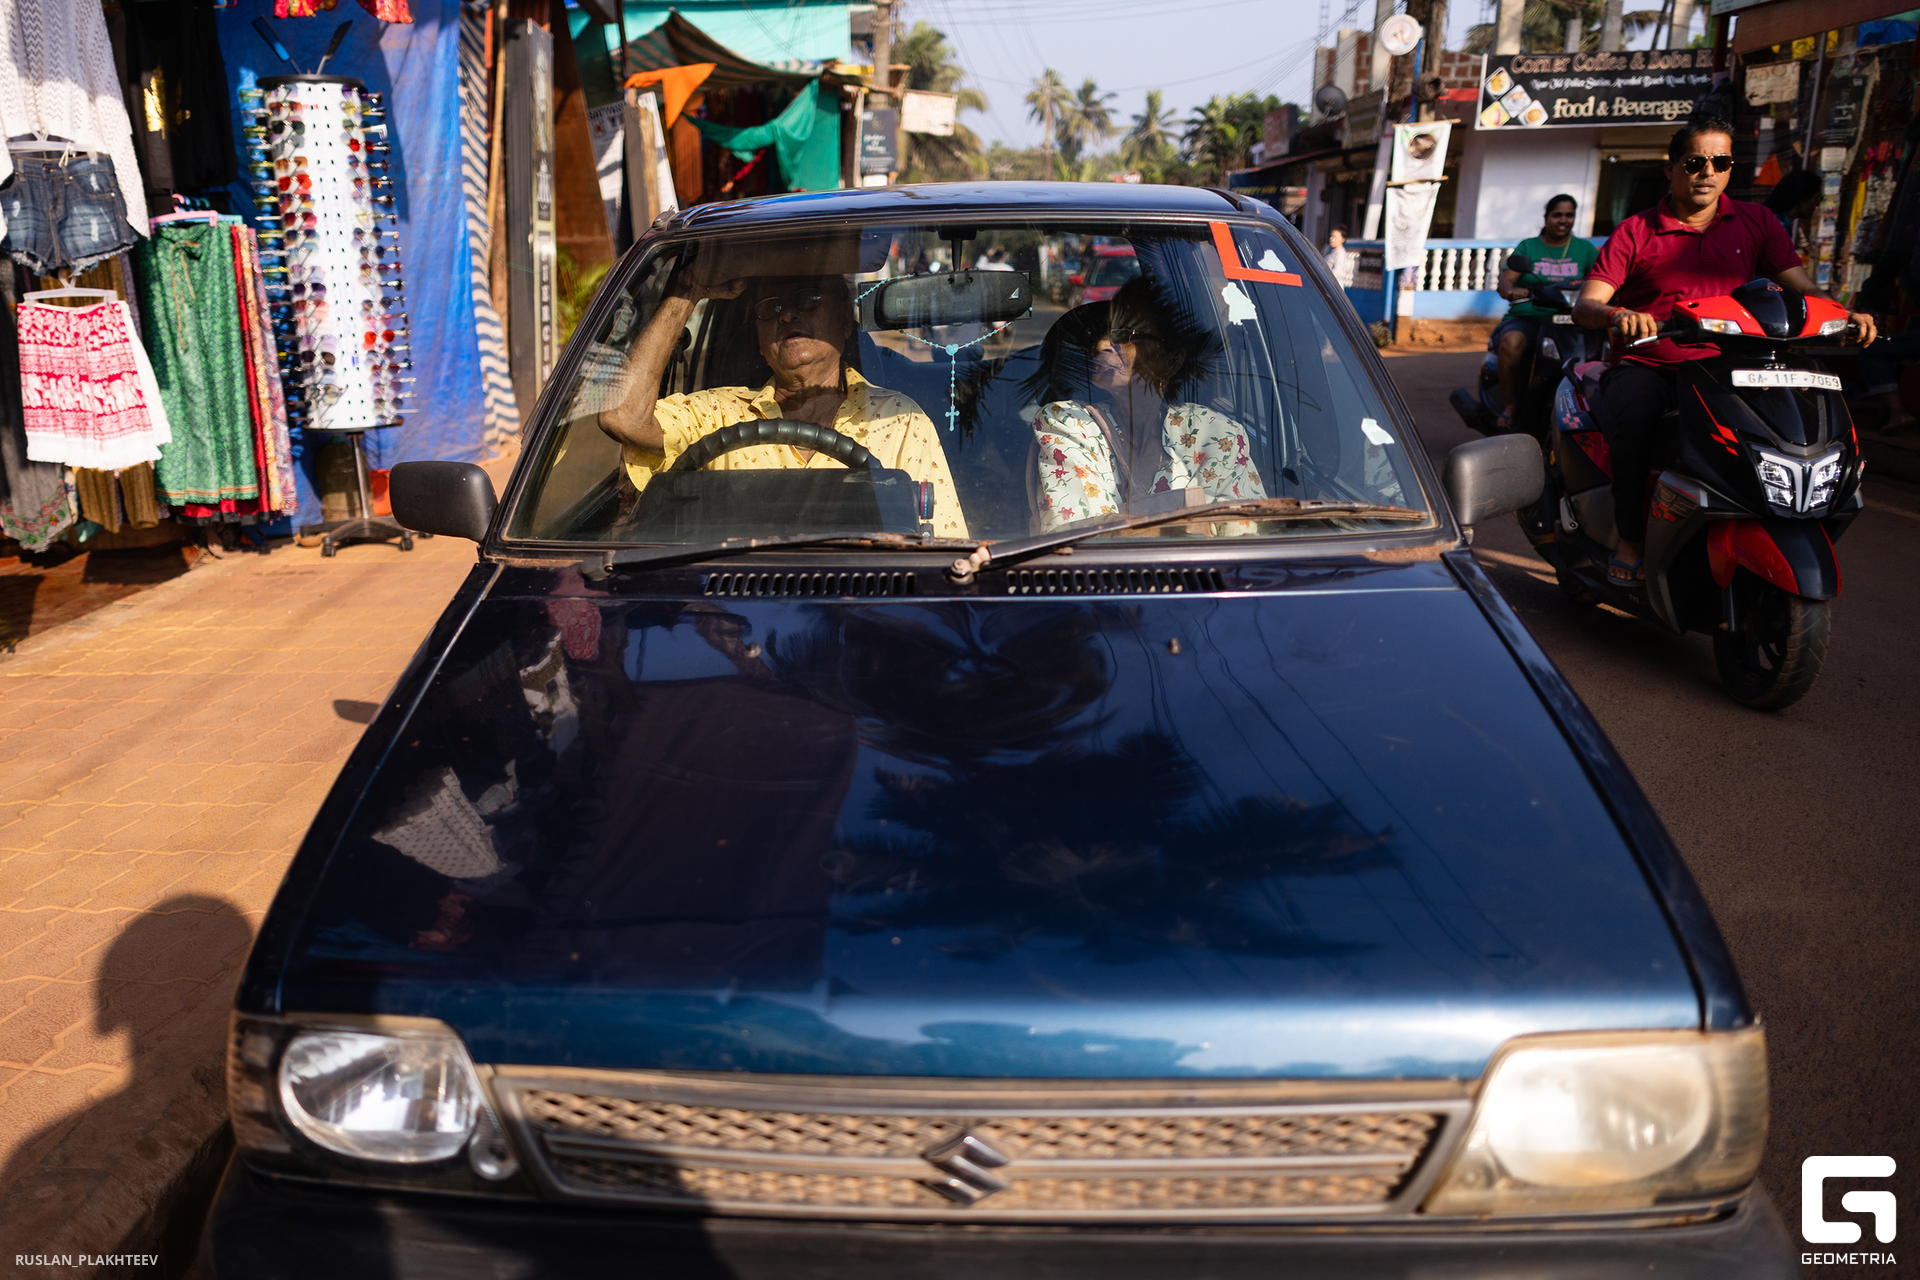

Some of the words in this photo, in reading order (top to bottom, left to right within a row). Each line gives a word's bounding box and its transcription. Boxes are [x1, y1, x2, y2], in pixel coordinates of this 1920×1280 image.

[1510, 55, 1571, 74] Corner
[1572, 52, 1628, 73] Coffee
[1629, 51, 1645, 70] &
[1648, 50, 1692, 70] Boba
[1553, 95, 1595, 119] Food
[1596, 100, 1610, 116] &
[1611, 97, 1694, 120] Beverages
[1748, 373, 1764, 384] GA
[1774, 373, 1797, 384] 11F
[1810, 374, 1840, 388] 7069
